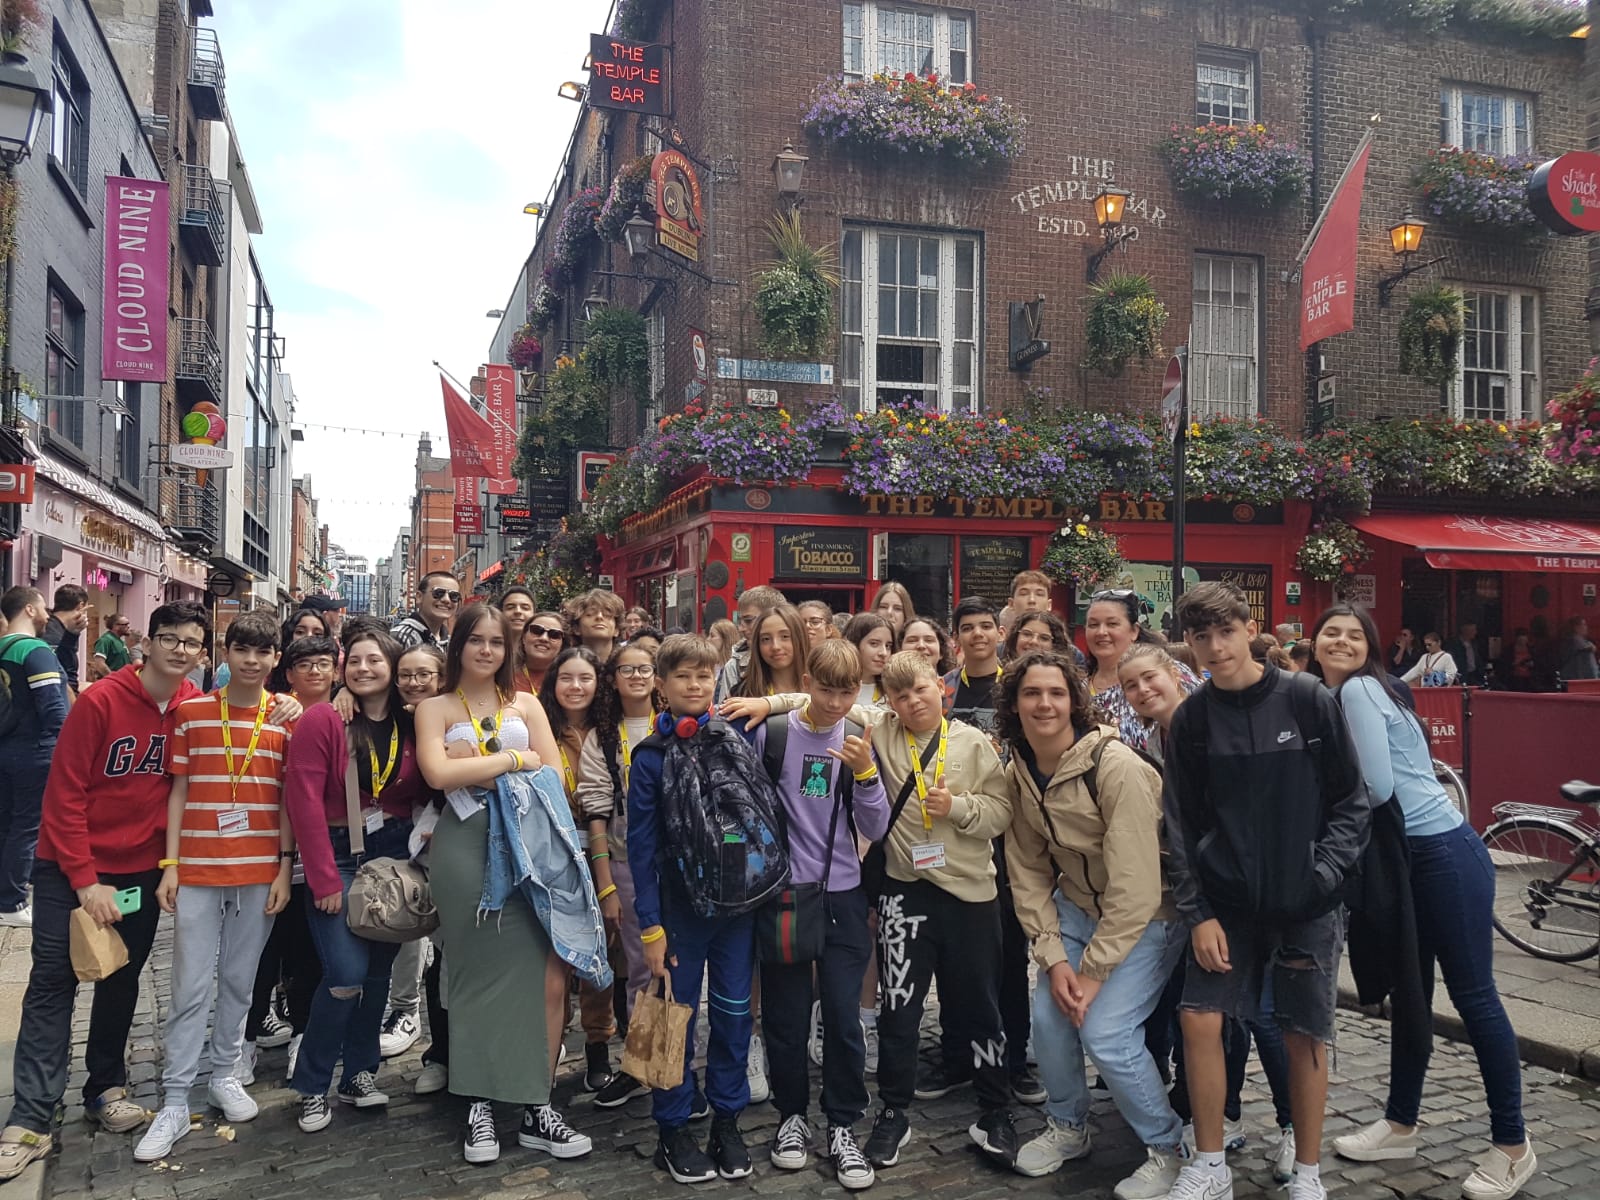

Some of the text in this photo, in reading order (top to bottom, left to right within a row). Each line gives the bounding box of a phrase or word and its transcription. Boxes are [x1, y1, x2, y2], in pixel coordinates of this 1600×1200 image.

[611, 42, 644, 62] THE
[594, 62, 660, 84] TEMPLE
[611, 86, 644, 103] BAR
[665, 155, 693, 177] TEMPLE
[1068, 156, 1115, 178] THE
[1562, 169, 1597, 199] Shack
[119, 186, 156, 252] NINE
[1125, 192, 1166, 229] BAR
[668, 224, 692, 240] DUBLIN
[1038, 216, 1090, 236] ESTD.
[664, 236, 696, 258] LIVE MUSIC
[1313, 275, 1330, 292] THE
[116, 262, 153, 353] CLOUD
[1307, 301, 1331, 322] BAR
[138, 362, 154, 370] NINE
[493, 384, 502, 406] BAR
[179, 447, 225, 458] CLOUD NINE
[861, 494, 1167, 520] THE TEMPLE BAR
[779, 530, 815, 547] Importers
[789, 546, 854, 568] TOBACCO
[970, 547, 1004, 558] TEMPLE
[1005, 548, 1023, 558] BAR
[1535, 556, 1560, 567] THE
[1247, 574, 1267, 588] 1840
[1431, 725, 1456, 736] BAR
[881, 982, 915, 1011] ITY
